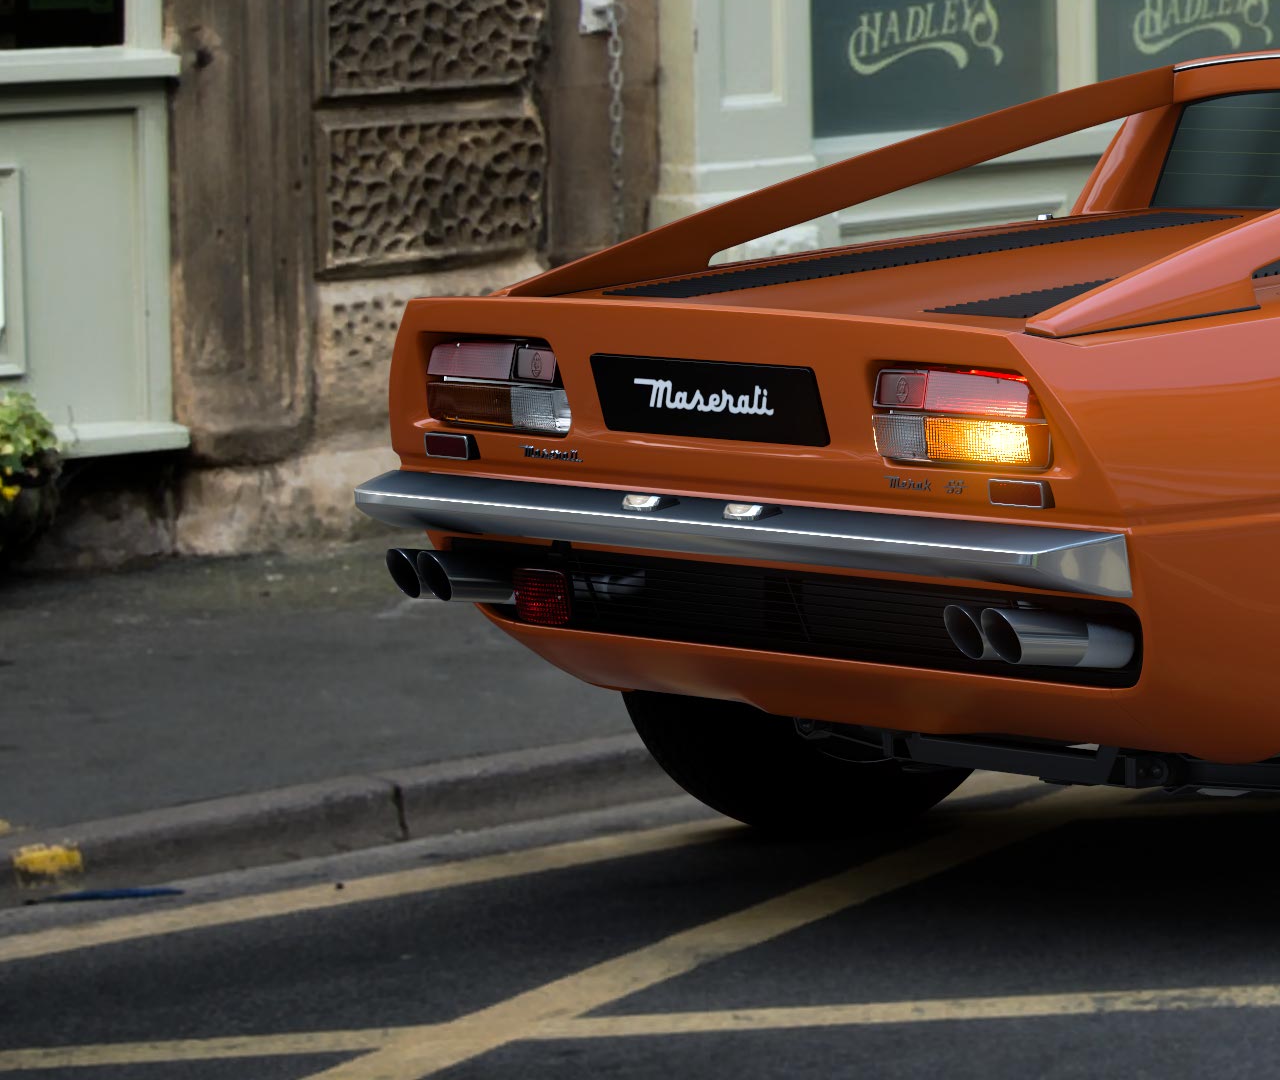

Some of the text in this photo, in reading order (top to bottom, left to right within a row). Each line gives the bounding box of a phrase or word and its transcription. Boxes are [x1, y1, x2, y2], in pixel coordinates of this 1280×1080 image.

[633, 377, 774, 417] Maserati
[519, 444, 584, 463] Maserati
[883, 474, 969, 495] Merak SS
